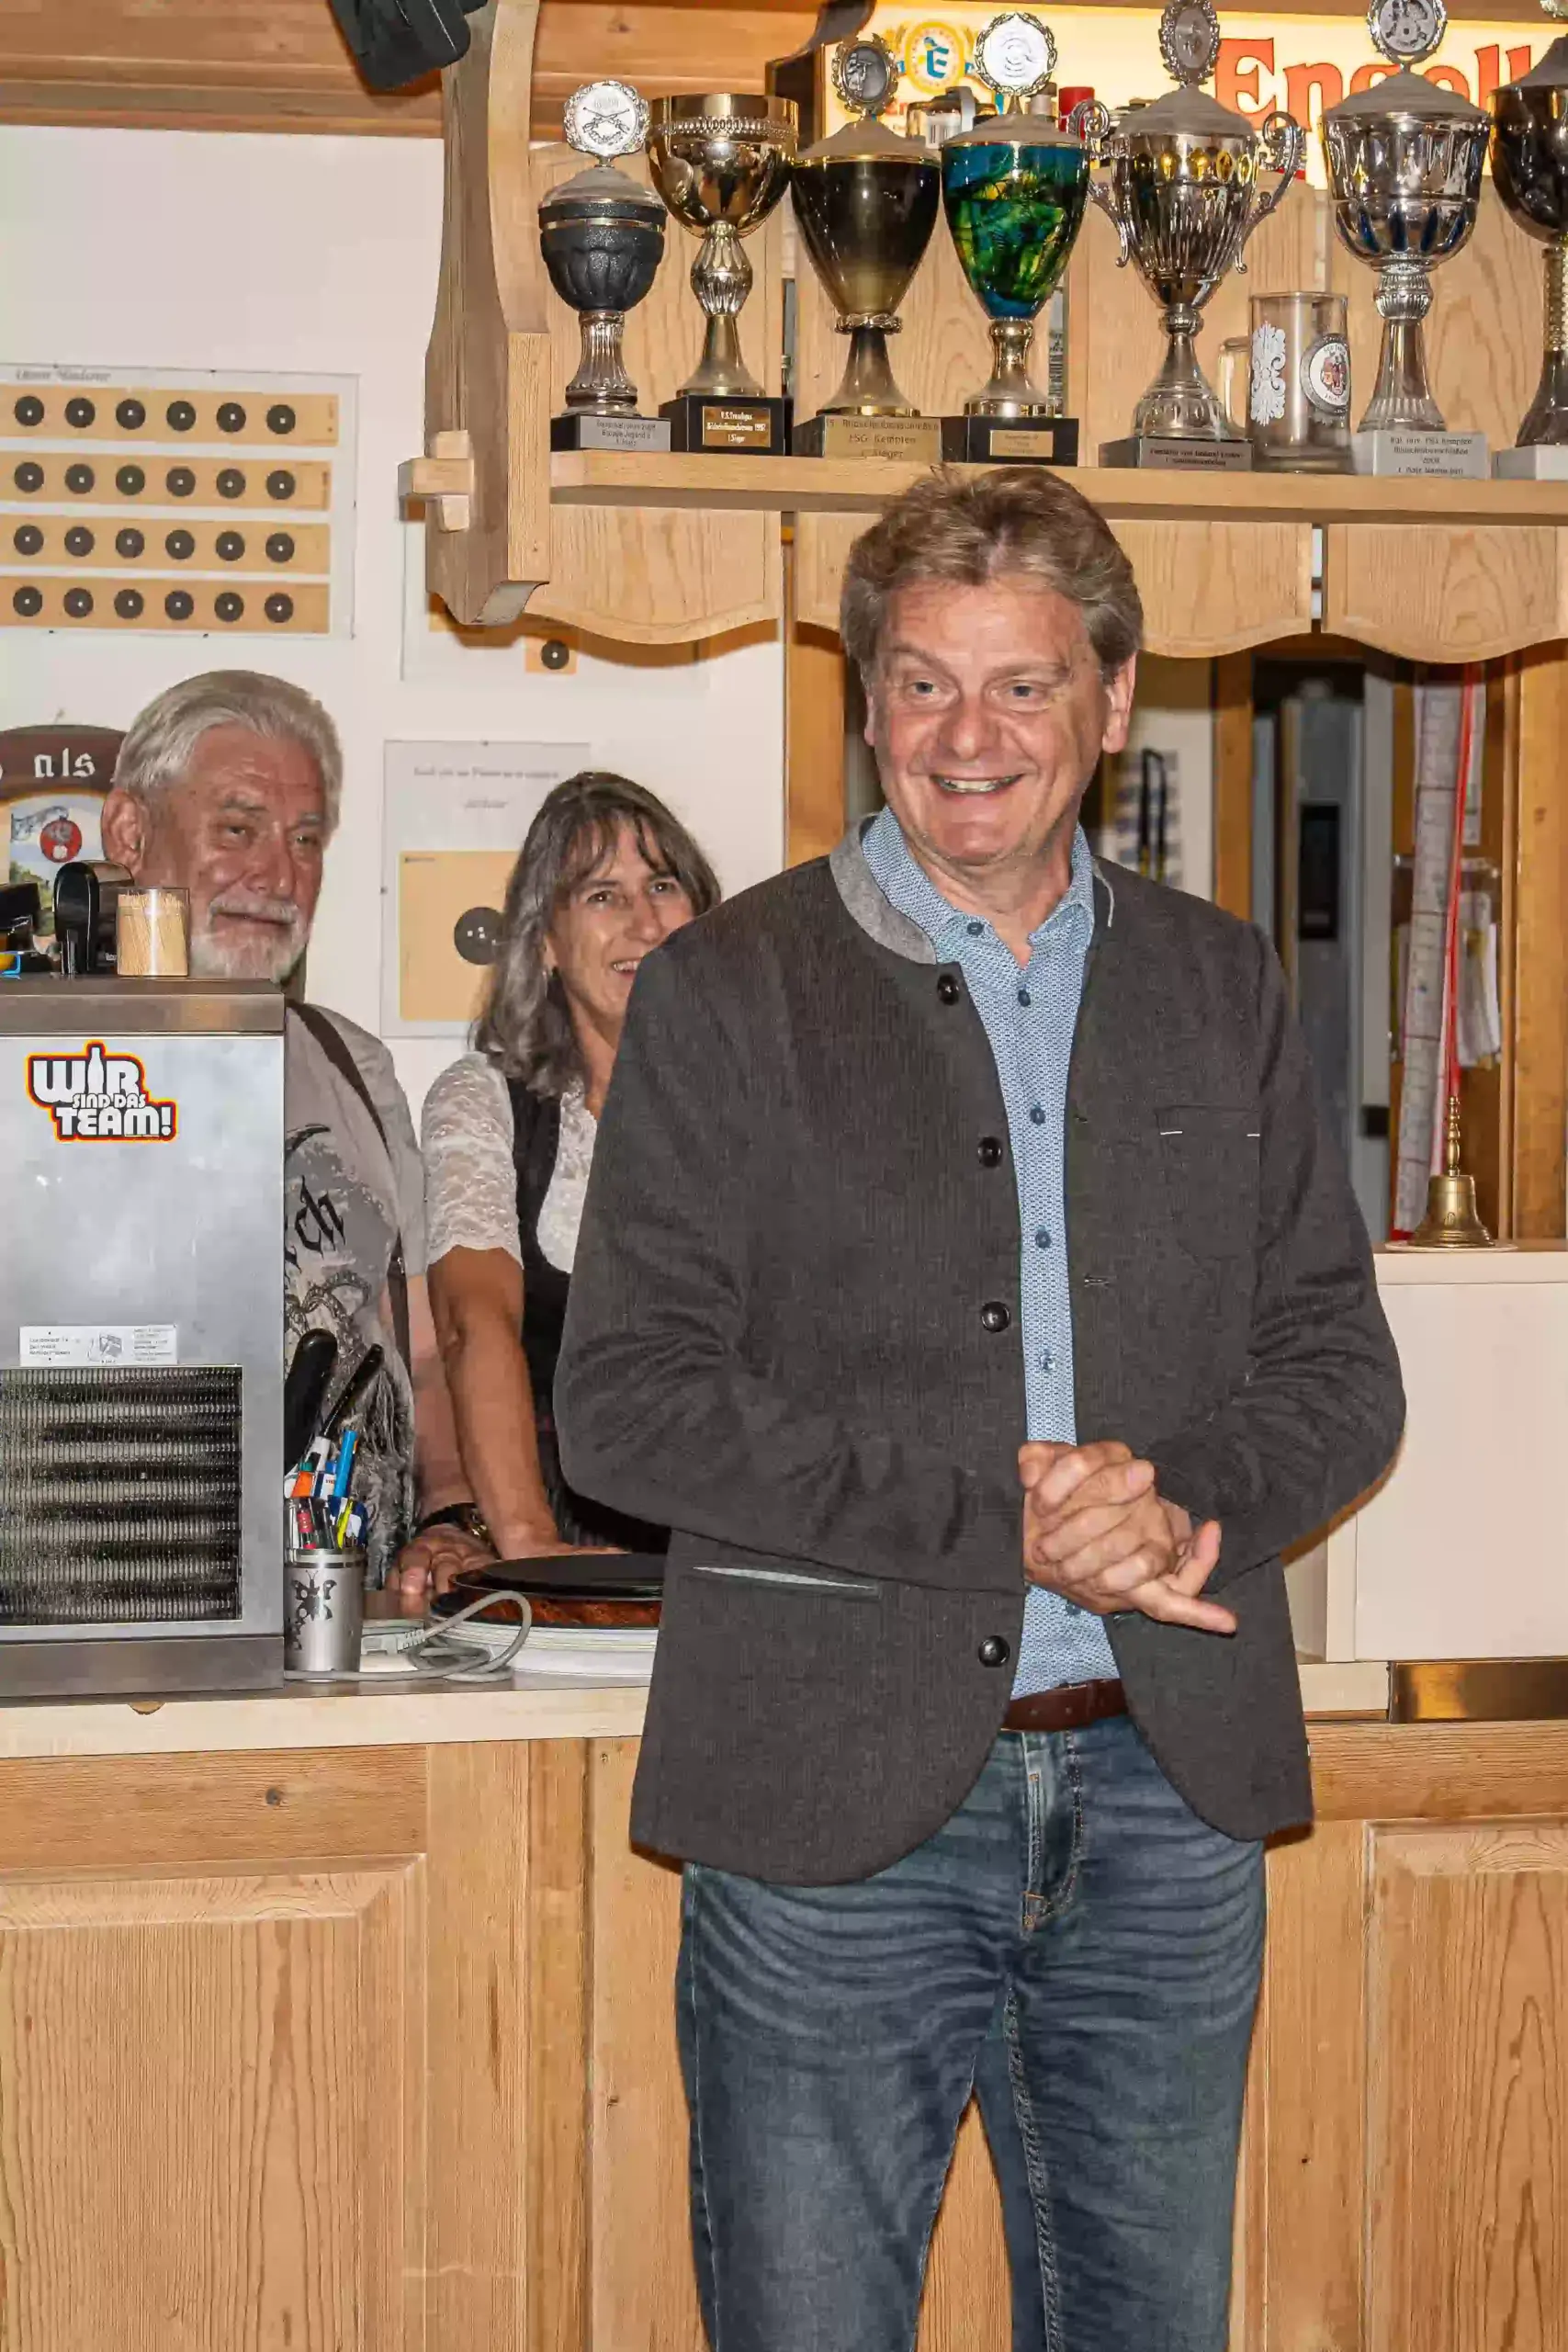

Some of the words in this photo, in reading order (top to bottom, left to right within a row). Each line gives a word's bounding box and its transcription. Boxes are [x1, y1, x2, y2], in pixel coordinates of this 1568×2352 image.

[874, 435, 916, 446] Kempten
[1441, 437, 1473, 447] Kempten
[34, 748, 96, 778] als
[32, 1046, 141, 1103] WIR
[72, 1093, 110, 1109] SIND
[113, 1093, 146, 1109] DAS
[55, 1106, 172, 1136] TEAM!
